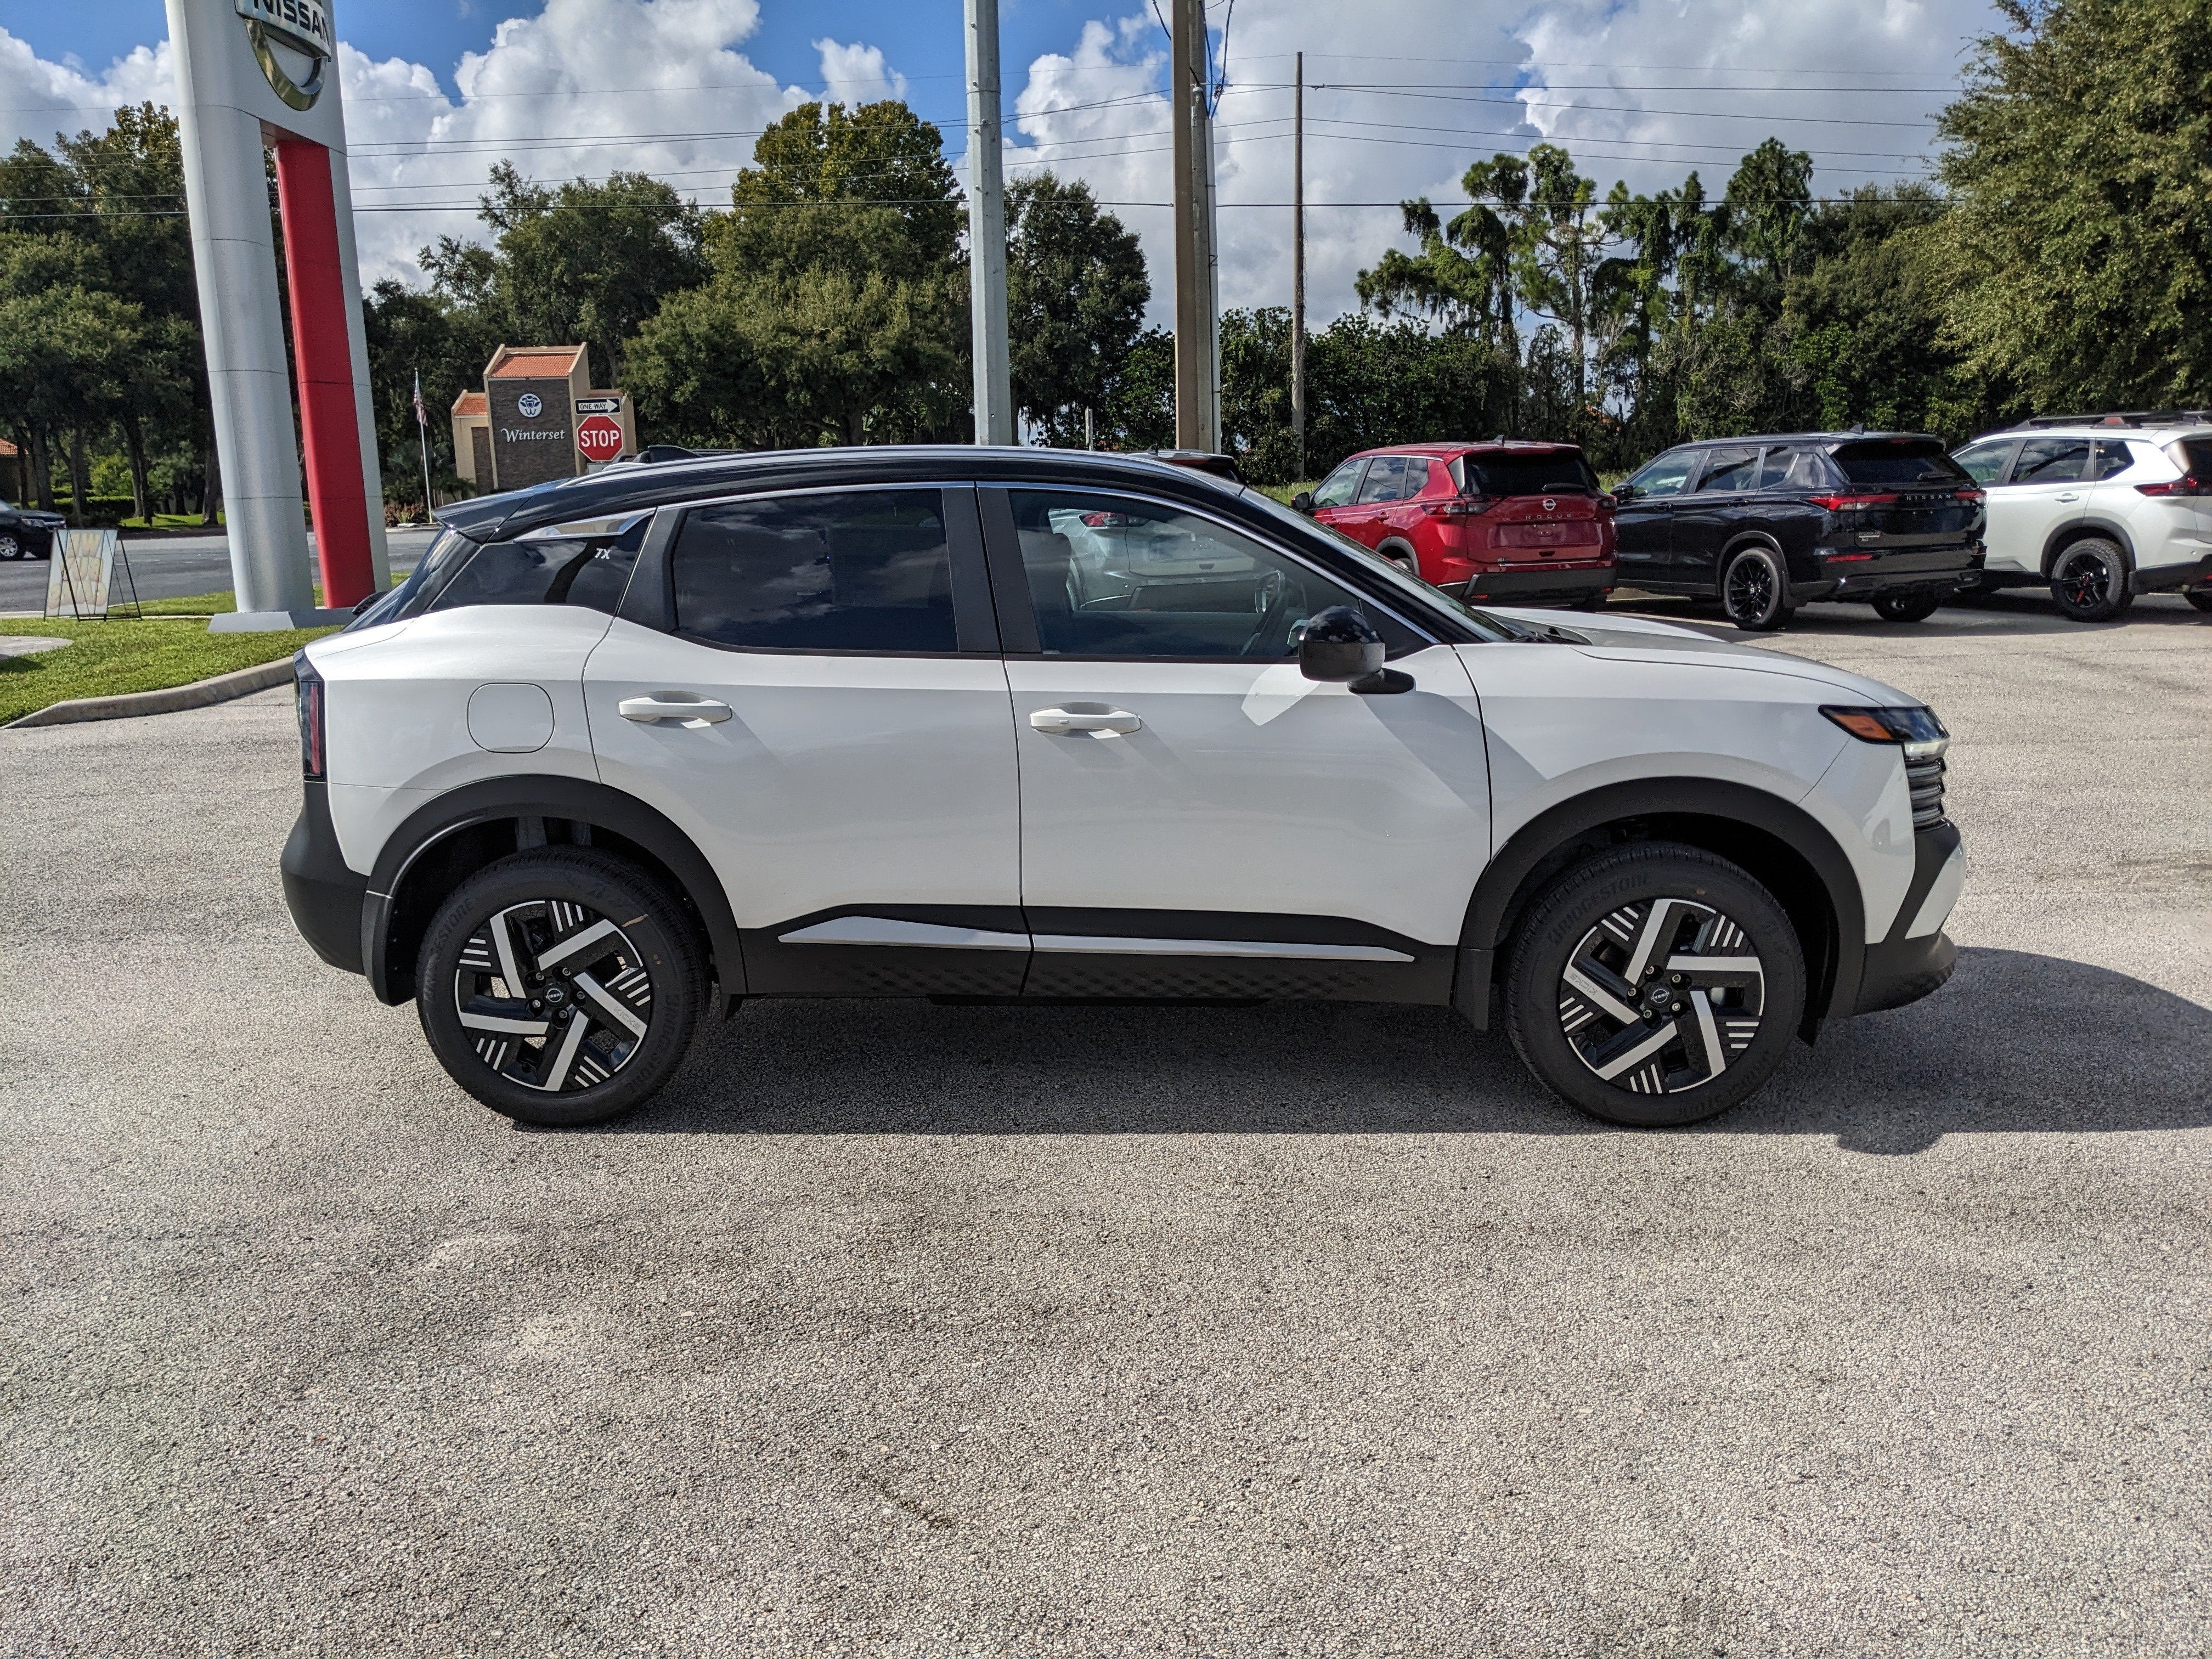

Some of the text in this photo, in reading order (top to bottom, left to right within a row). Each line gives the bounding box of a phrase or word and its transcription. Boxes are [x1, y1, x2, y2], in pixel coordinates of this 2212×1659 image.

[500, 428, 566, 443] Winterset
[580, 430, 619, 447] STOP
[1570, 973, 1598, 996] KICKS
[613, 1006, 640, 1030] KICKS
